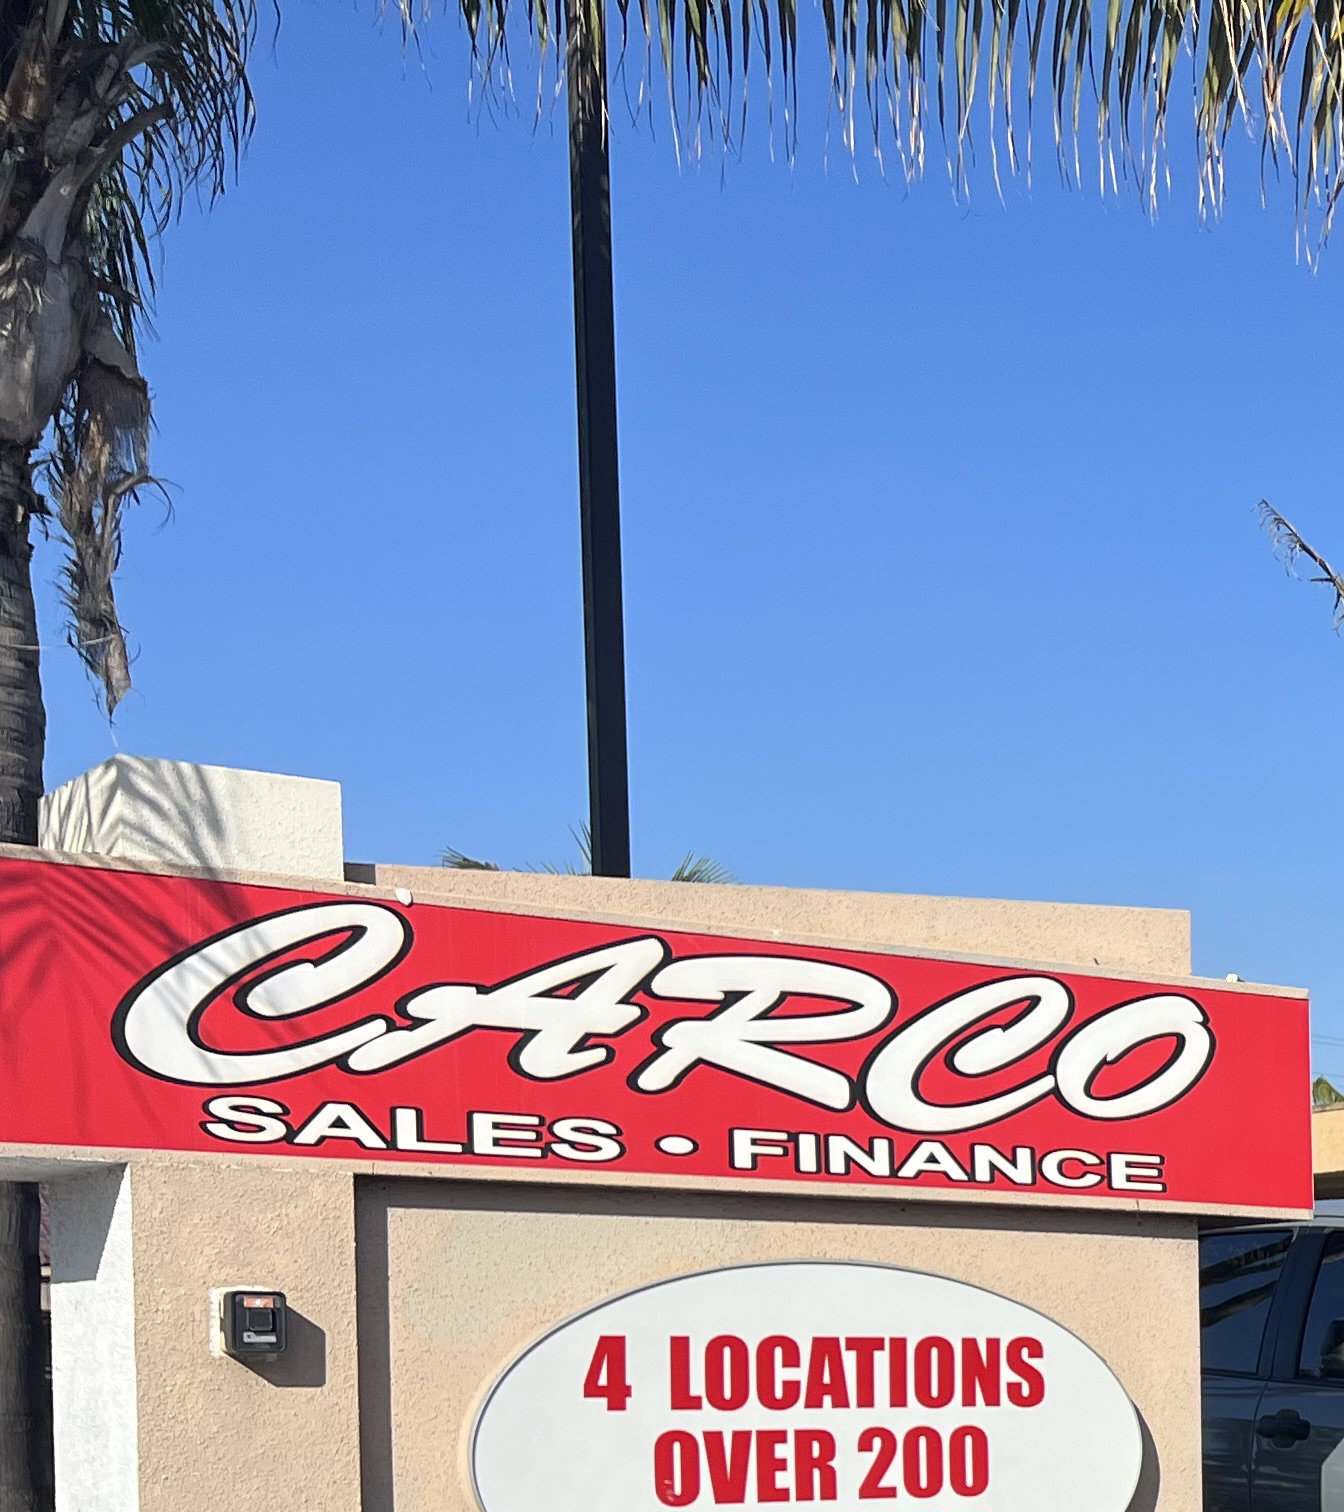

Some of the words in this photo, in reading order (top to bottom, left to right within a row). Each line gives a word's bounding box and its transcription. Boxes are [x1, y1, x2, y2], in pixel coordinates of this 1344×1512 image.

[111, 899, 1217, 1134] CARCO
[200, 1095, 625, 1163] SALES
[729, 1127, 1167, 1193] FINANCE
[583, 1335, 632, 1411] 4
[669, 1335, 1045, 1411] LOCATIONS
[653, 1428, 838, 1508] OVER
[856, 1425, 990, 1501] 200
